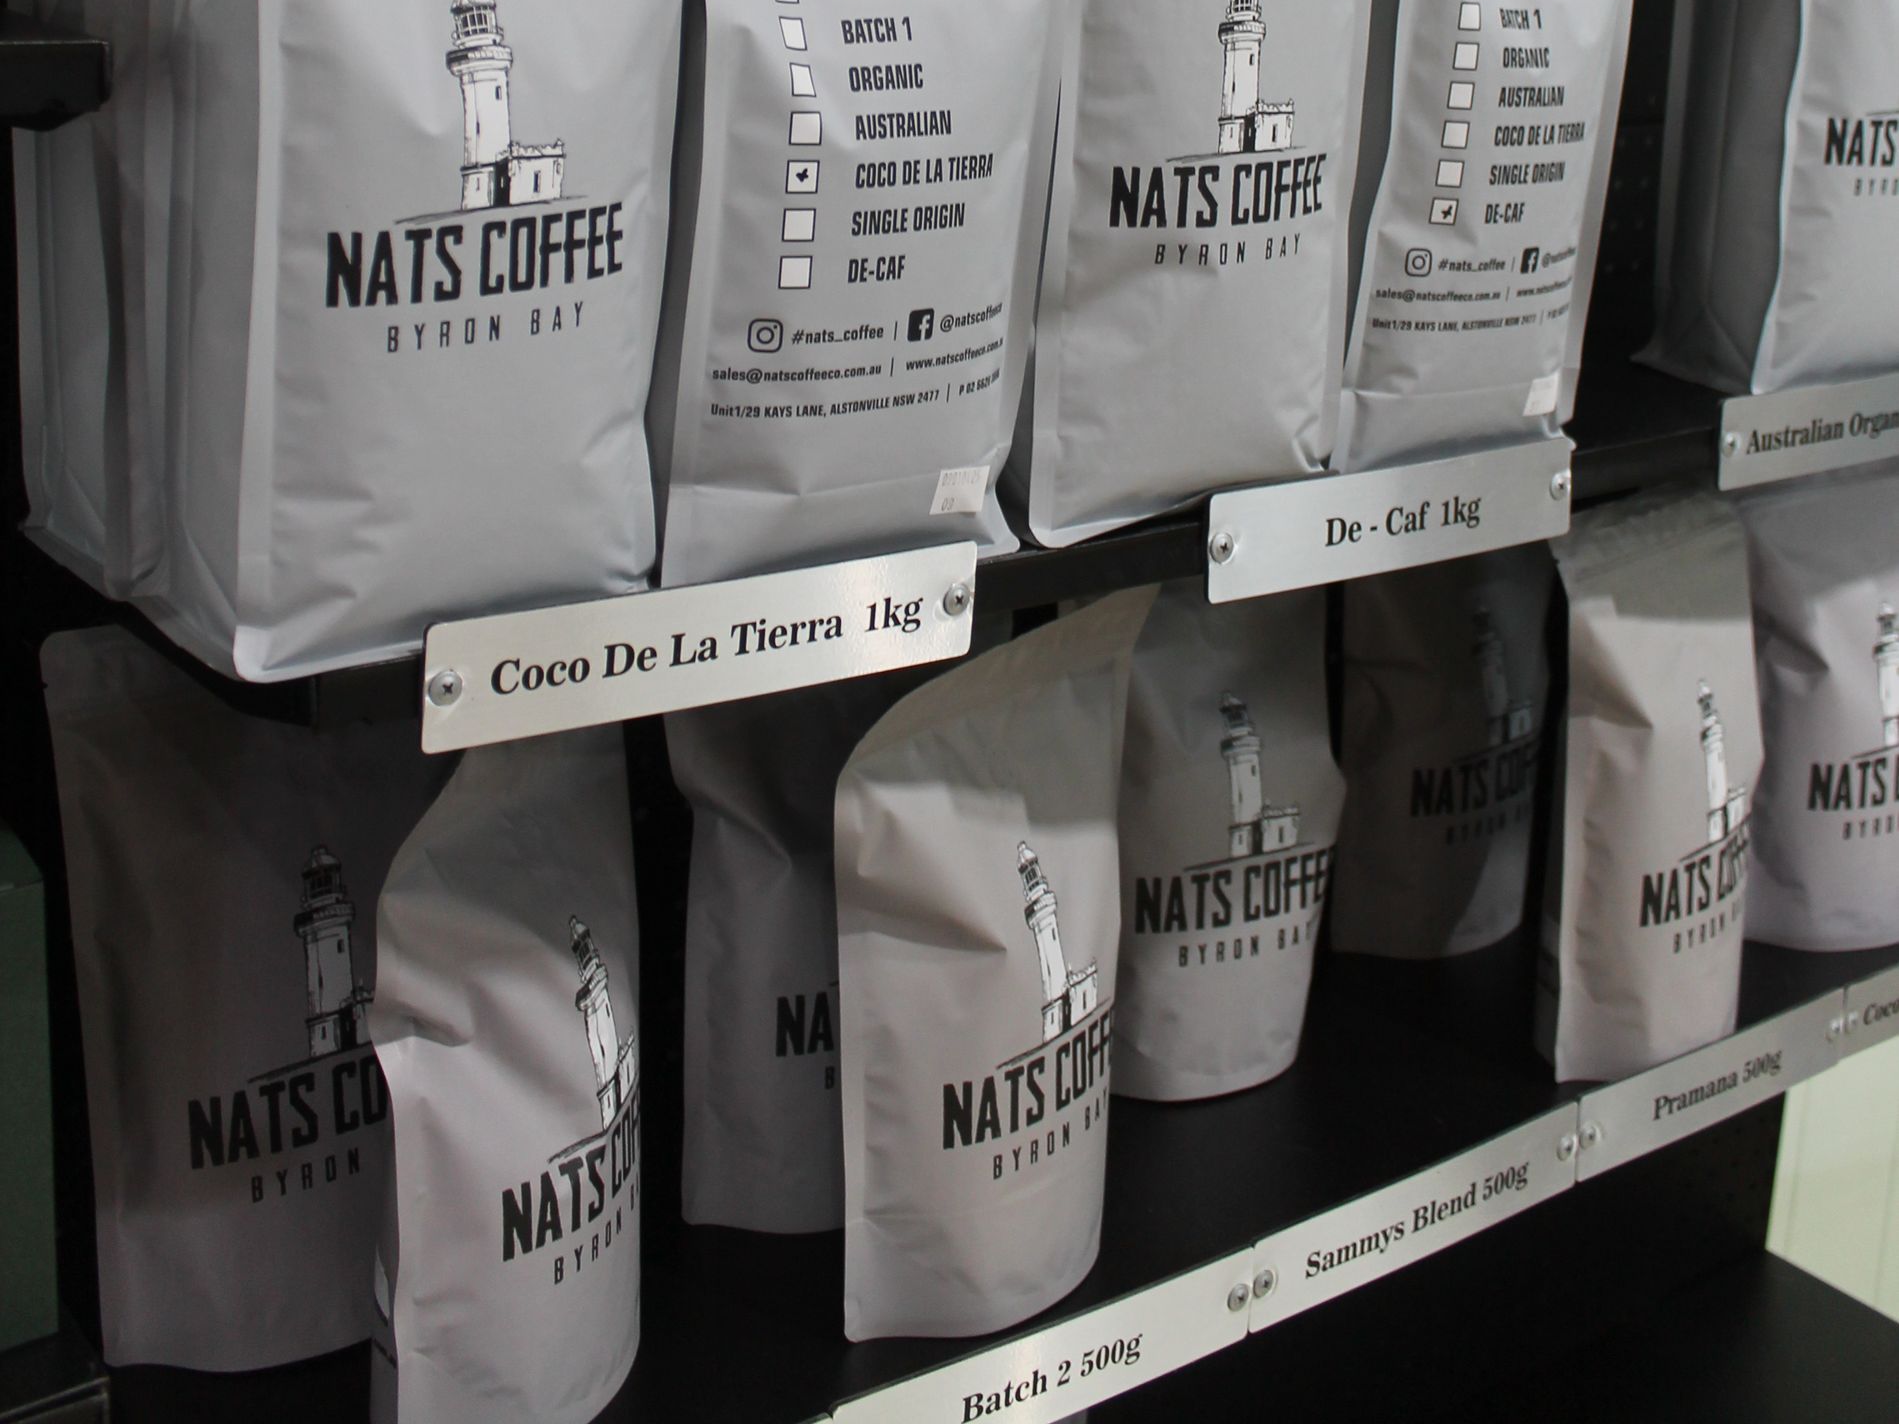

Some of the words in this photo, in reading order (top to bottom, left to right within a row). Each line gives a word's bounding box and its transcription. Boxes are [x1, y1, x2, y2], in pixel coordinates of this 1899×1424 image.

[841, 17, 898, 45] BATCH
[902, 17, 912, 41] 1
[1499, 8, 1530, 29] BATCH
[1534, 9, 1542, 29] 1
[849, 64, 924, 92] ORGANIC
[1503, 46, 1550, 69] ORGANIC
[1498, 86, 1565, 108] AUSTRALIAN
[855, 110, 952, 141] AUSTRALIAN
[1494, 126, 1524, 147] COCO
[1527, 125, 1540, 146] DE
[1543, 124, 1554, 145] LA
[1824, 117, 1898, 166] NATS
[855, 161, 897, 189] COCO
[902, 159, 921, 186] DE
[925, 157, 943, 183] LA
[948, 153, 994, 182] TIERRA
[1109, 165, 1220, 228] NATS
[1231, 153, 1327, 226] COFFEE
[1489, 164, 1529, 186] SINGLE
[1532, 162, 1565, 184] ORIGIN
[851, 208, 908, 237] SINGLE
[912, 202, 965, 233] ORIGIN
[1484, 203, 1525, 224] DE-CAF
[325, 225, 463, 308] NATS
[479, 202, 624, 296] COFFEE
[847, 255, 906, 284] DE-CAF
[1155, 241, 1246, 265] BYRON
[1265, 233, 1300, 259] BAY
[387, 315, 500, 353] BYRON
[530, 301, 583, 336] BAY
[792, 324, 884, 345] #nats_coffee
[712, 363, 882, 384] sales@natscoffeeco.com.au
[764, 404, 793, 419] KAYS
[796, 404, 827, 419] LANE,
[830, 397, 890, 415] ALSTONVILLE
[892, 394, 915, 407] NSW
[917, 389, 940, 404] 2477
[1746, 419, 1844, 455] Australian
[1325, 517, 1361, 547] De
[1385, 501, 1430, 537] Caf
[1441, 496, 1482, 528] 1kg
[490, 657, 590, 695] Coco
[602, 643, 658, 679] De
[669, 633, 718, 668] La
[731, 614, 843, 657] Tierra
[864, 596, 923, 634] 1kg
[1410, 758, 1488, 817] NATS
[1808, 757, 1886, 811] NATS
[1135, 868, 1232, 935] NATS
[1640, 855, 1711, 927] NATS
[1178, 935, 1260, 967] BYRON
[943, 1056, 1045, 1150] NATS
[1653, 1070, 1737, 1121] Pramana
[1742, 1050, 1782, 1083] 500g
[188, 1072, 319, 1170] NATS
[993, 1121, 1070, 1180] BYRON
[251, 1147, 360, 1204] BYRON
[502, 1144, 605, 1262] NATS
[1305, 1221, 1405, 1279] Sammys
[1411, 1183, 1477, 1234] Blend
[1482, 1162, 1530, 1202] 500g
[554, 1206, 622, 1285] BYRON
[961, 1367, 1048, 1424] Batch
[1057, 1360, 1072, 1387] 2
[1080, 1333, 1144, 1378] 500g
